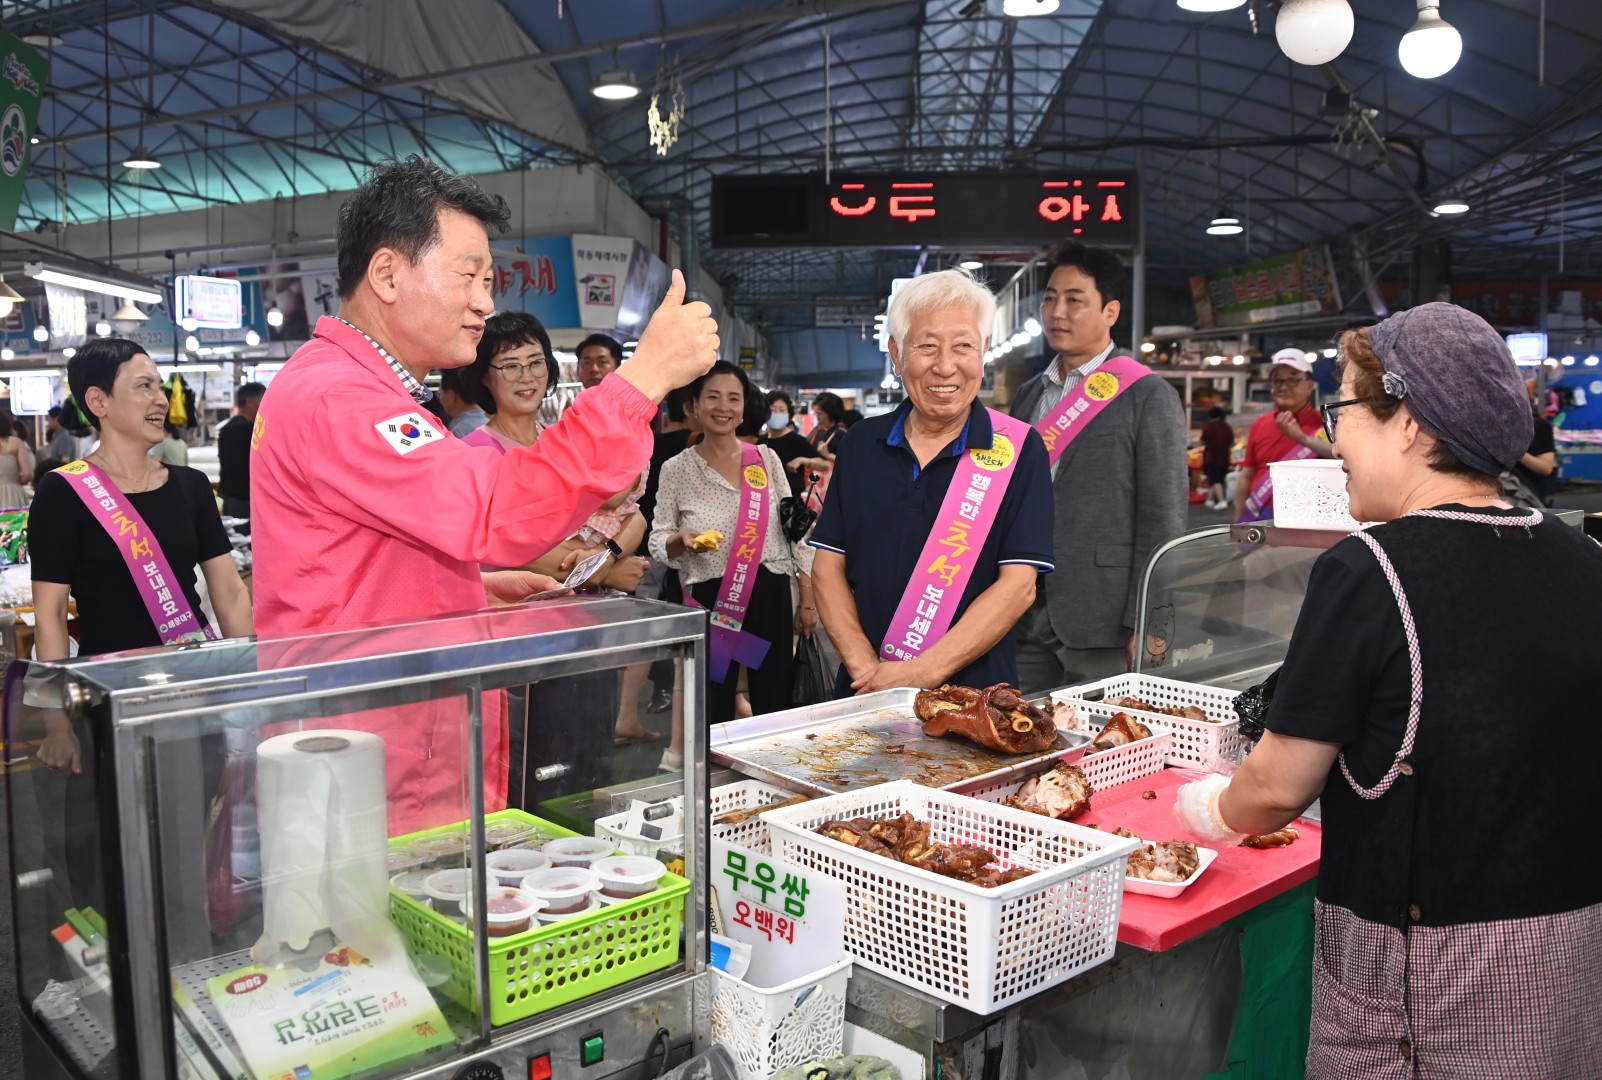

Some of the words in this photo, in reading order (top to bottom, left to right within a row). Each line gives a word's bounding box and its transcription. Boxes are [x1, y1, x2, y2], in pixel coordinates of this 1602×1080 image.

[1056, 397, 1090, 431] 행복한
[975, 452, 1004, 467] 해운대
[1042, 426, 1062, 452] 추
[748, 490, 762, 521] 행복한
[959, 473, 992, 521] 행복한
[81, 474, 119, 512] 행복한
[109, 511, 154, 561] 추석
[142, 560, 179, 618] 보내세요
[736, 521, 759, 563] 추석
[927, 519, 972, 588] 추석
[727, 562, 749, 603] 보내세요
[167, 611, 193, 629] 해운대구
[723, 602, 745, 613] 해운대구
[902, 584, 944, 651] 보내세요
[722, 849, 811, 918] 무우쌈
[233, 975, 262, 994] 50매
[272, 994, 382, 1047] 크린장갑
